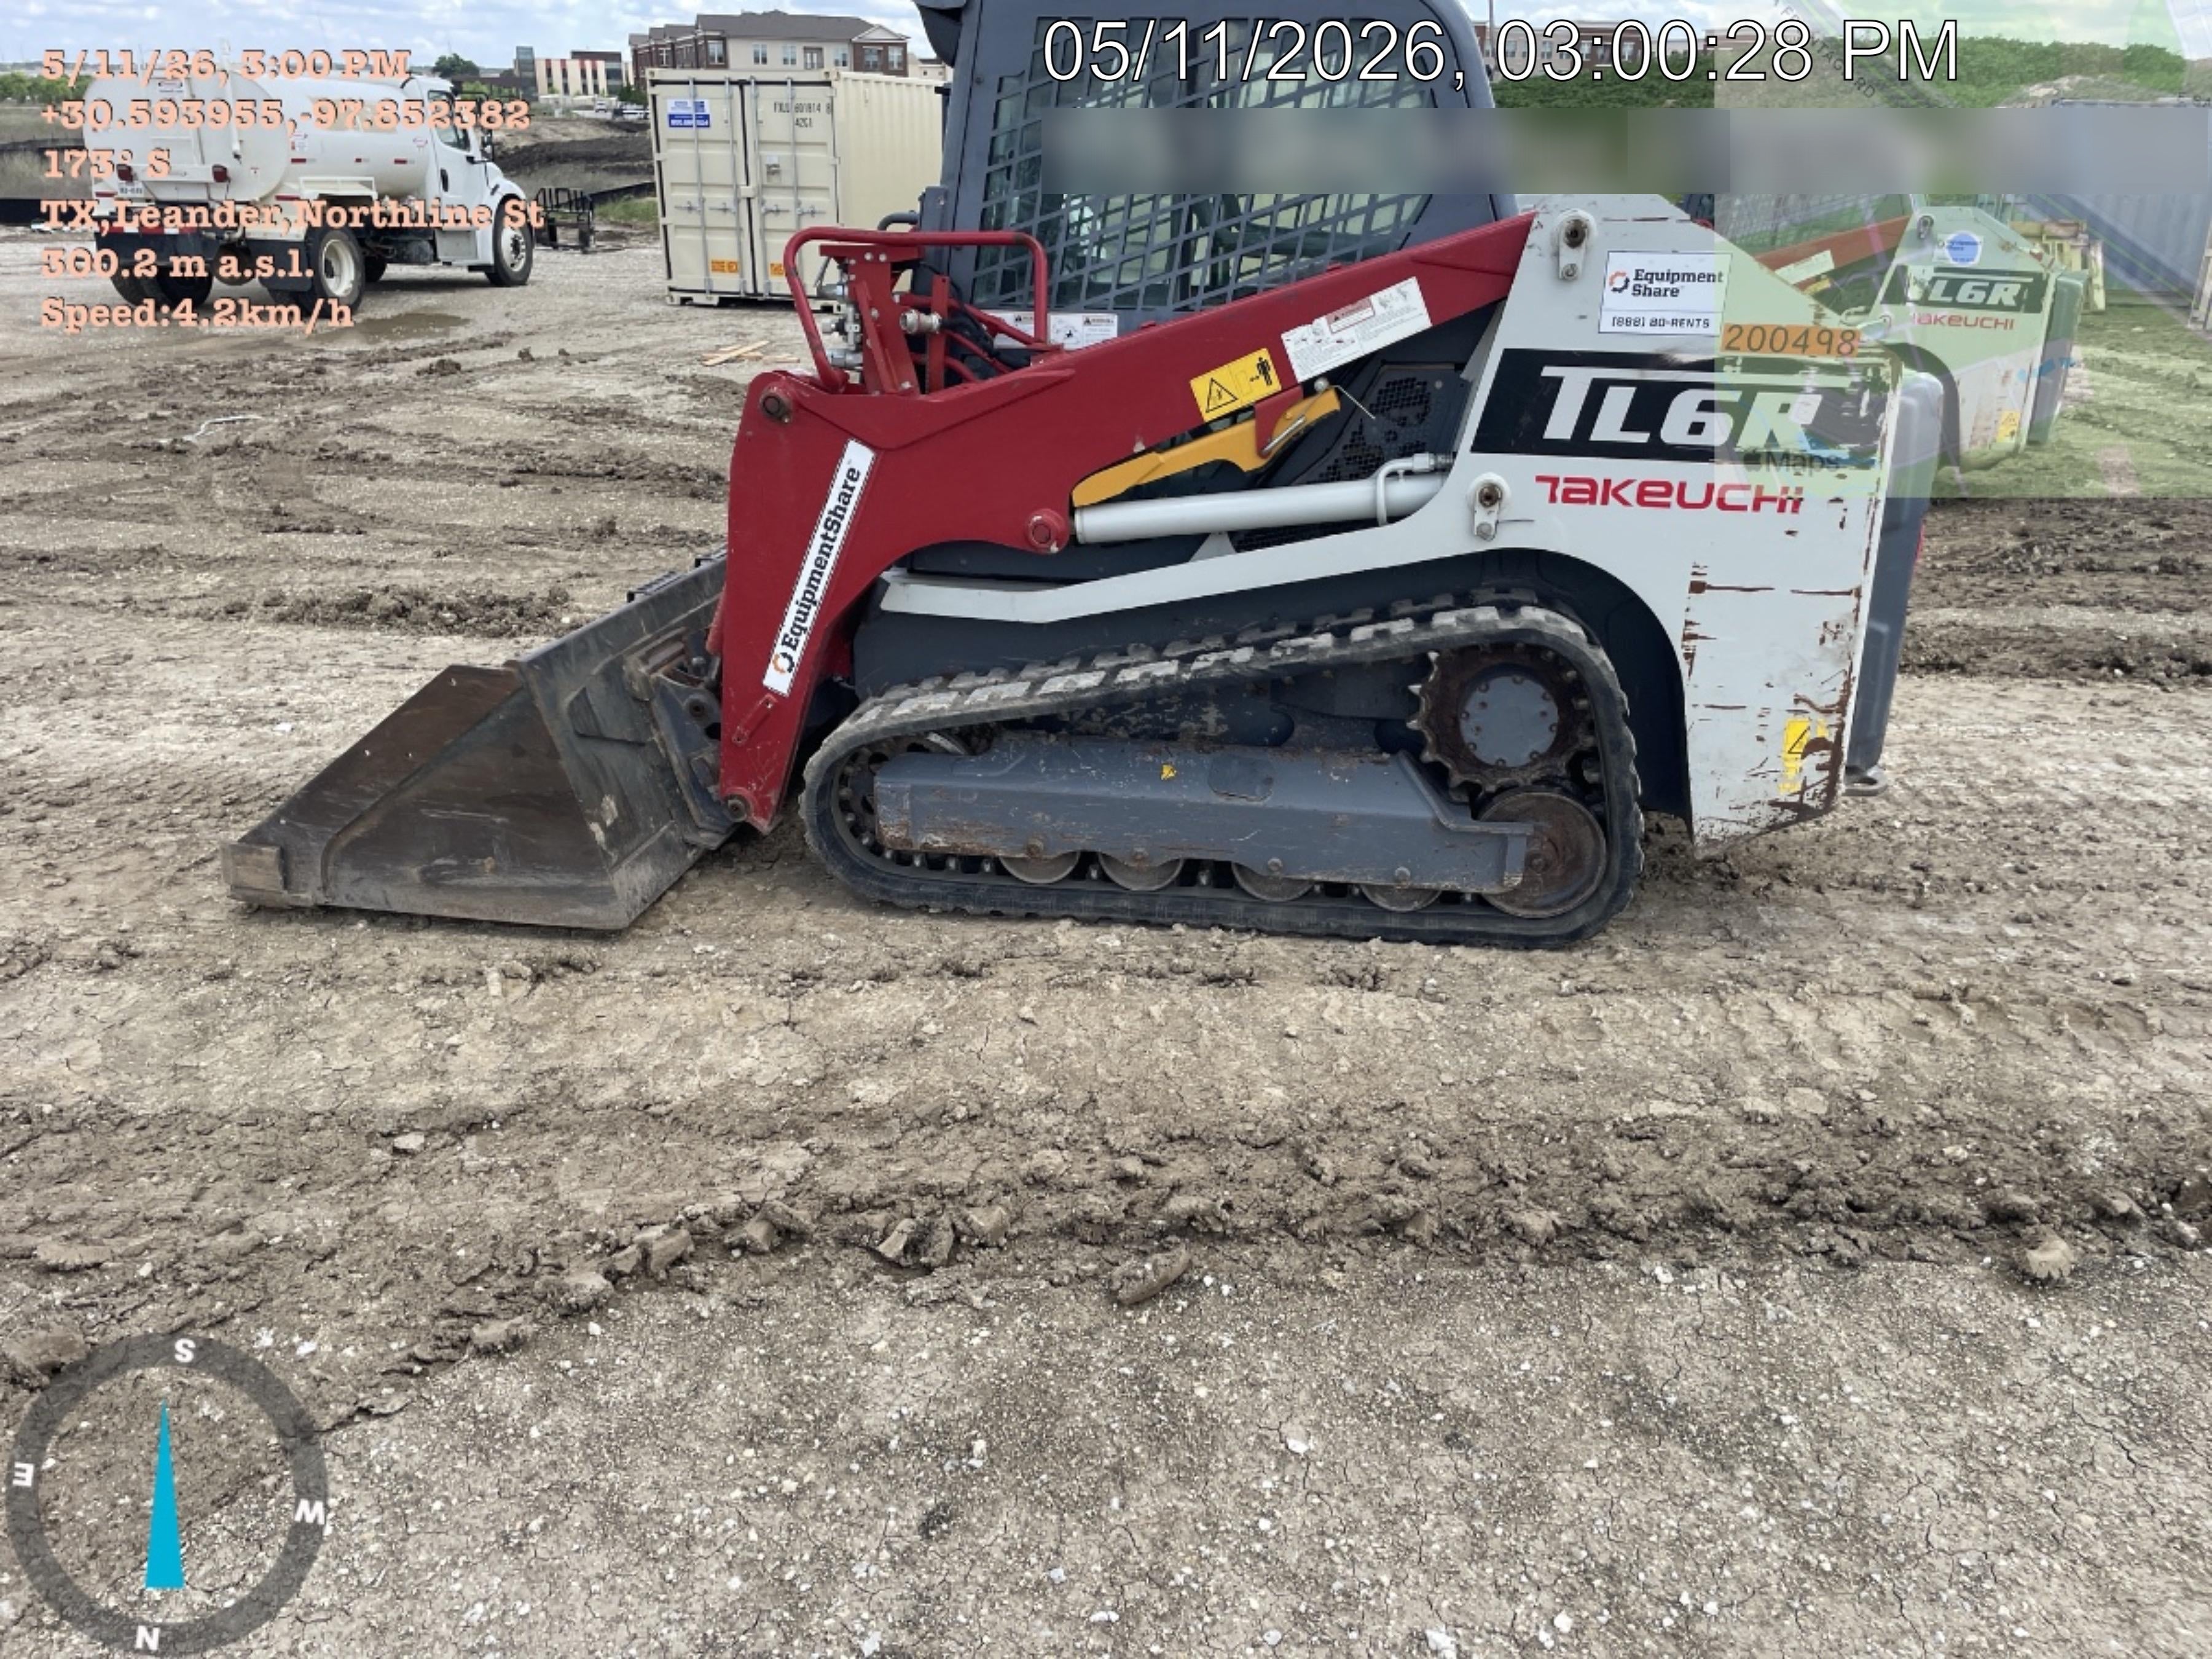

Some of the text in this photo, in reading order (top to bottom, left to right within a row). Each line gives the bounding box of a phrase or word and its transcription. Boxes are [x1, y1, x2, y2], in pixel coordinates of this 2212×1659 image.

[1631, 283, 1681, 297] Share
[1633, 269, 1725, 284] Equipment
[1724, 324, 1856, 355] 200498
[1540, 365, 1849, 452] TL6R
[781, 467, 861, 652] EquipmentShare
